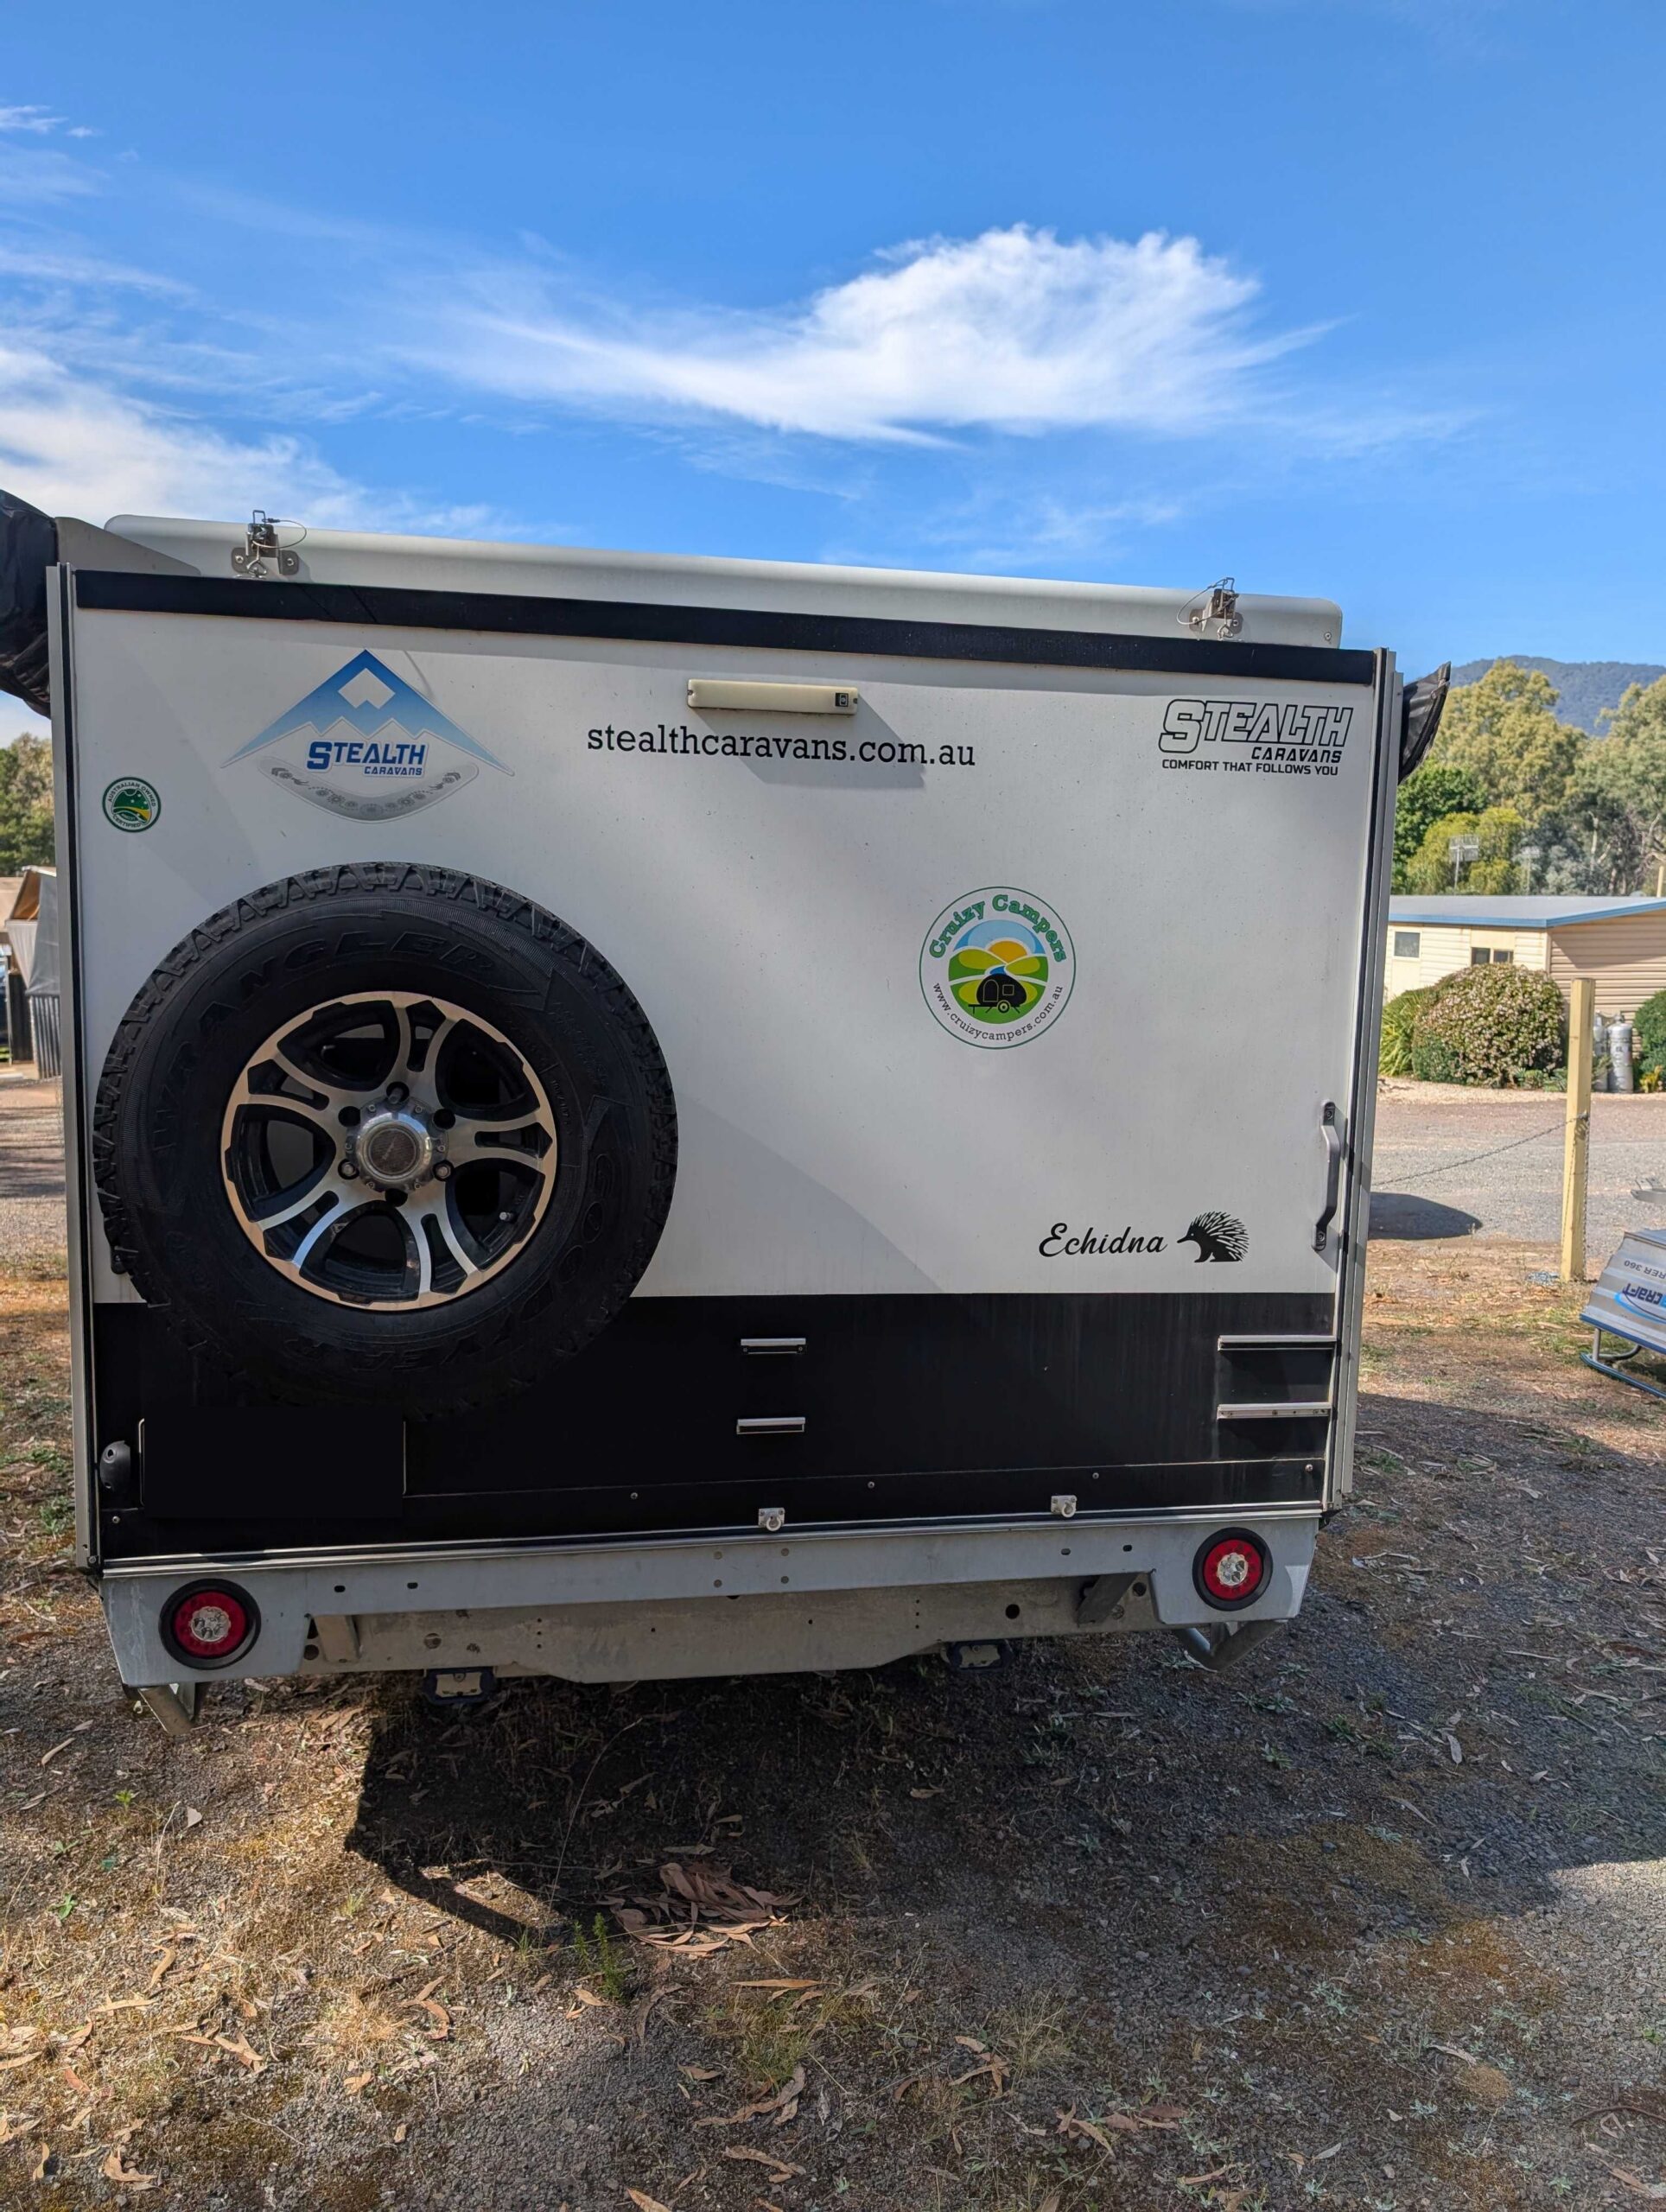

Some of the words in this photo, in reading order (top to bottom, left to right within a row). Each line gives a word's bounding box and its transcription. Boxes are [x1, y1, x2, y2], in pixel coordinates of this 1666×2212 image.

[1158, 698, 1354, 754] STEALTH
[307, 741, 426, 771] STEALTH
[588, 724, 976, 766] stealthcaravans.com.au
[1251, 746, 1343, 764] CARAVANS
[364, 766, 423, 777] CARAVANS
[1161, 759, 1219, 771] COMFORT
[1223, 761, 1253, 772] THAT
[1256, 763, 1312, 775] FOLLOWS
[1314, 765, 1339, 776] YOU
[107, 781, 140, 803] AUSTRALIAN
[141, 786, 156, 807] OWNED
[112, 813, 141, 828] CERTIFIED
[929, 900, 986, 958] Cruizy
[992, 894, 1067, 963] Campers
[932, 982, 1064, 1042] www.cruizycampers.com.au
[1039, 1222, 1168, 1257] Echidna
[1624, 1259, 1643, 1272] 360
